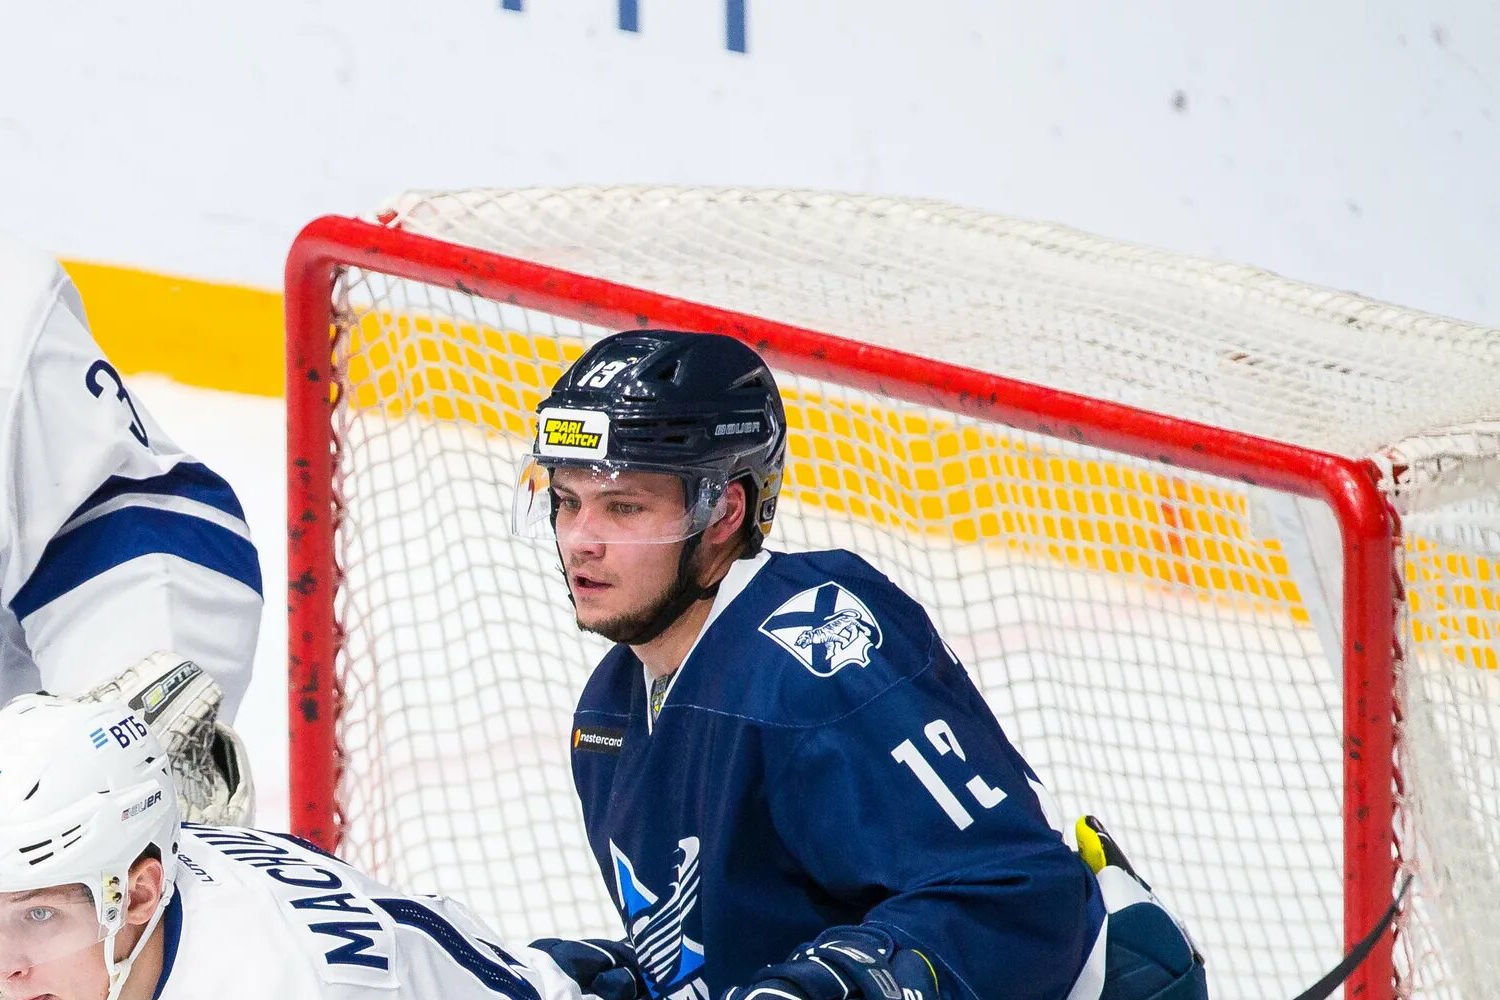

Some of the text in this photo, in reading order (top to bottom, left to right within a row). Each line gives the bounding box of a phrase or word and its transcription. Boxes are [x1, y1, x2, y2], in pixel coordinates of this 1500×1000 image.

[577, 360, 627, 388] 13
[545, 419, 582, 434] PARI
[715, 421, 761, 436] BAUER
[548, 432, 599, 448] MATCH
[108, 715, 148, 749] ВТБ
[580, 733, 624, 747] mastercard
[121, 790, 162, 822] BAUER
